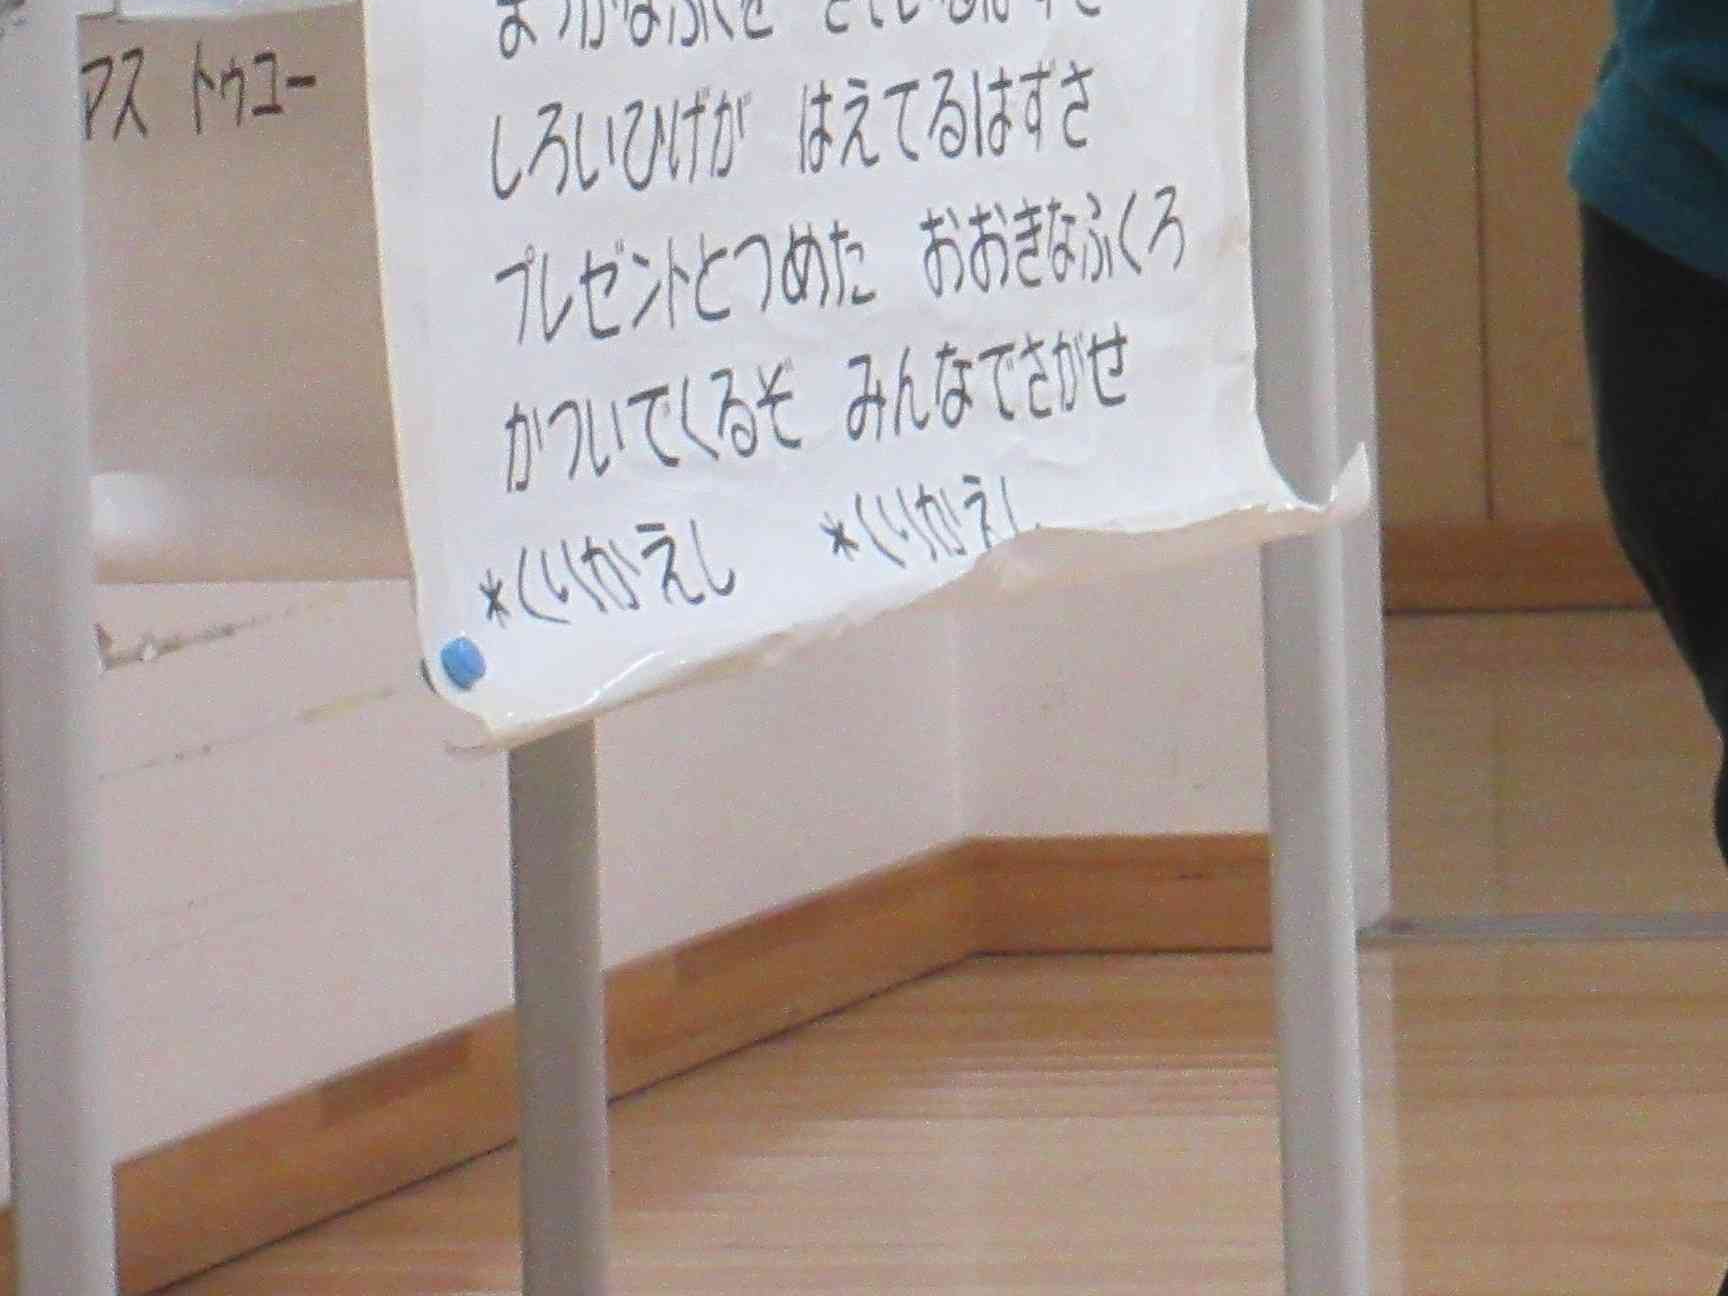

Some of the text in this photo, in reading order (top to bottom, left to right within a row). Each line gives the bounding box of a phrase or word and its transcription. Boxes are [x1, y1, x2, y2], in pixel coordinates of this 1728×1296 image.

[490, 58, 1097, 202] しろいひげが はえてるはずさ
[919, 184, 1187, 299] おおきなふくろ
[847, 320, 1131, 445] みんなでさがせ
